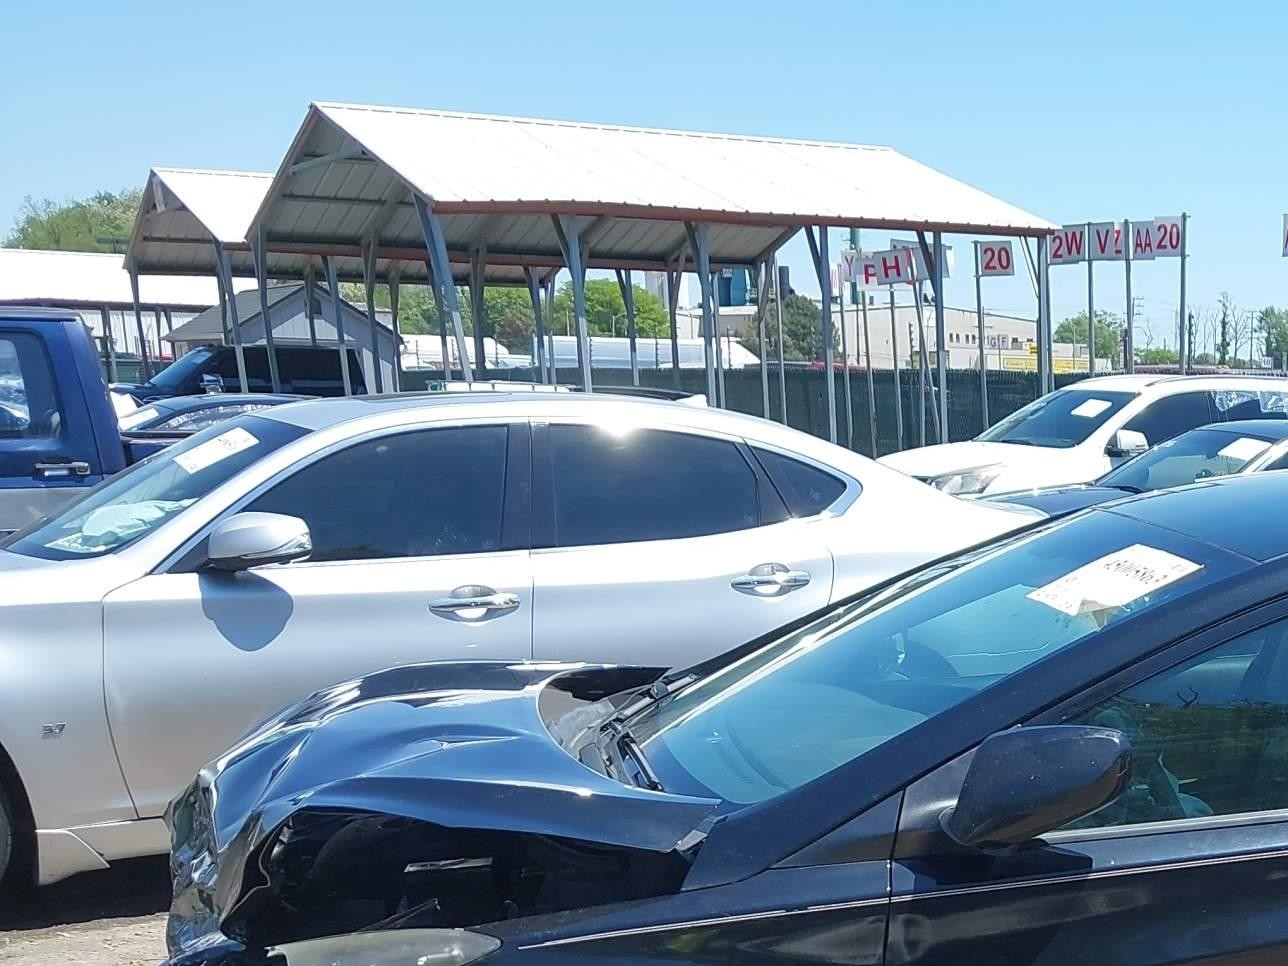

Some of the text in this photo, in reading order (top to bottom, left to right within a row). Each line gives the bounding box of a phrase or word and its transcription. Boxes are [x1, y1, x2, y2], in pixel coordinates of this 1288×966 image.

[1052, 235, 1063, 259] 2
[1064, 231, 1083, 256] W
[1096, 229, 1109, 254] V
[1135, 227, 1153, 254] AA
[1156, 223, 1180, 250] 20
[882, 255, 901, 279] H
[983, 246, 1011, 271] 20
